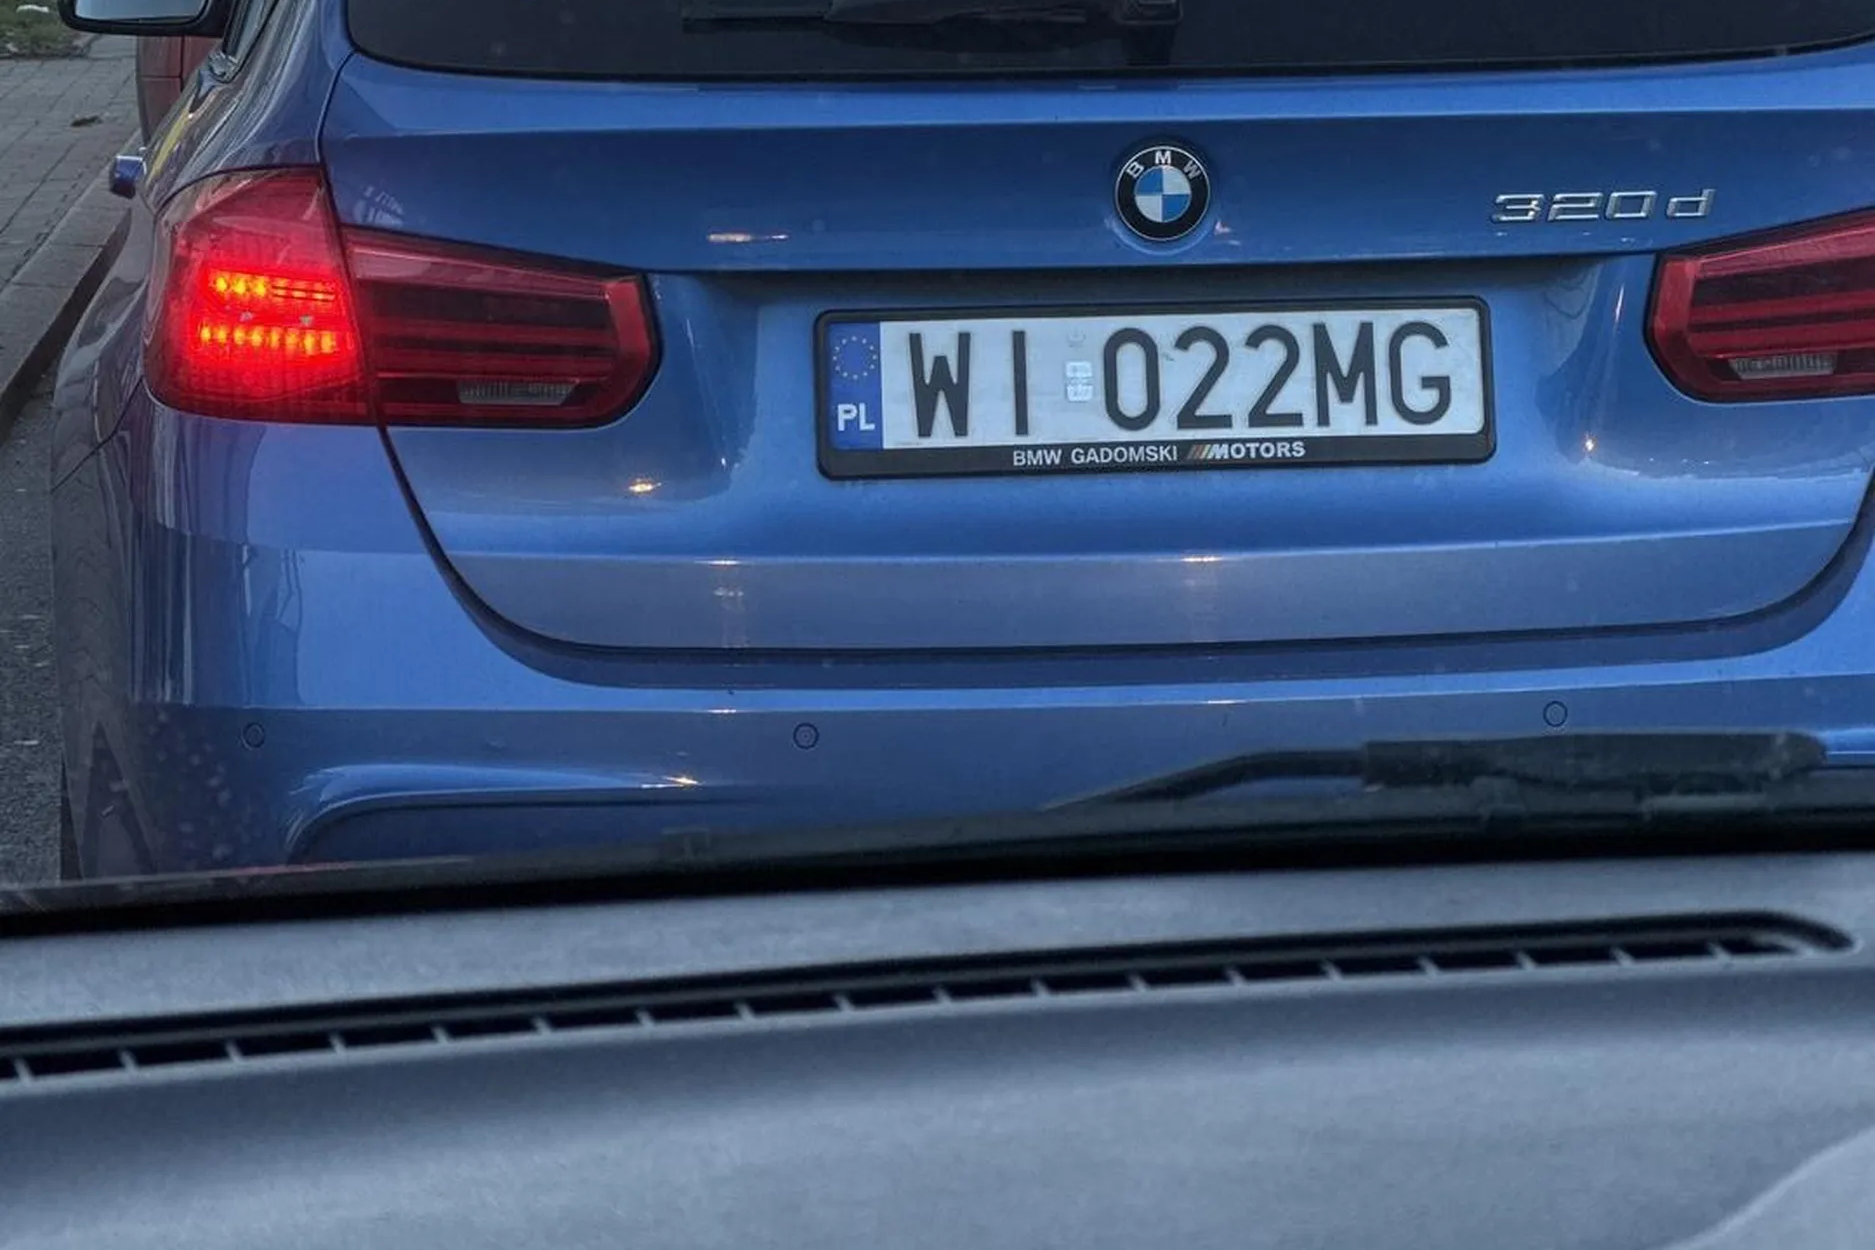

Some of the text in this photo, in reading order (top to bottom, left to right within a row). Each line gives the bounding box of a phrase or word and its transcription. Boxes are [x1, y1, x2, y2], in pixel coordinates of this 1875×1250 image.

[1126, 150, 1201, 179] BMW
[837, 403, 876, 432] PL
[1013, 449, 1062, 467] BMW
[1071, 445, 1178, 464] GADOMSKI
